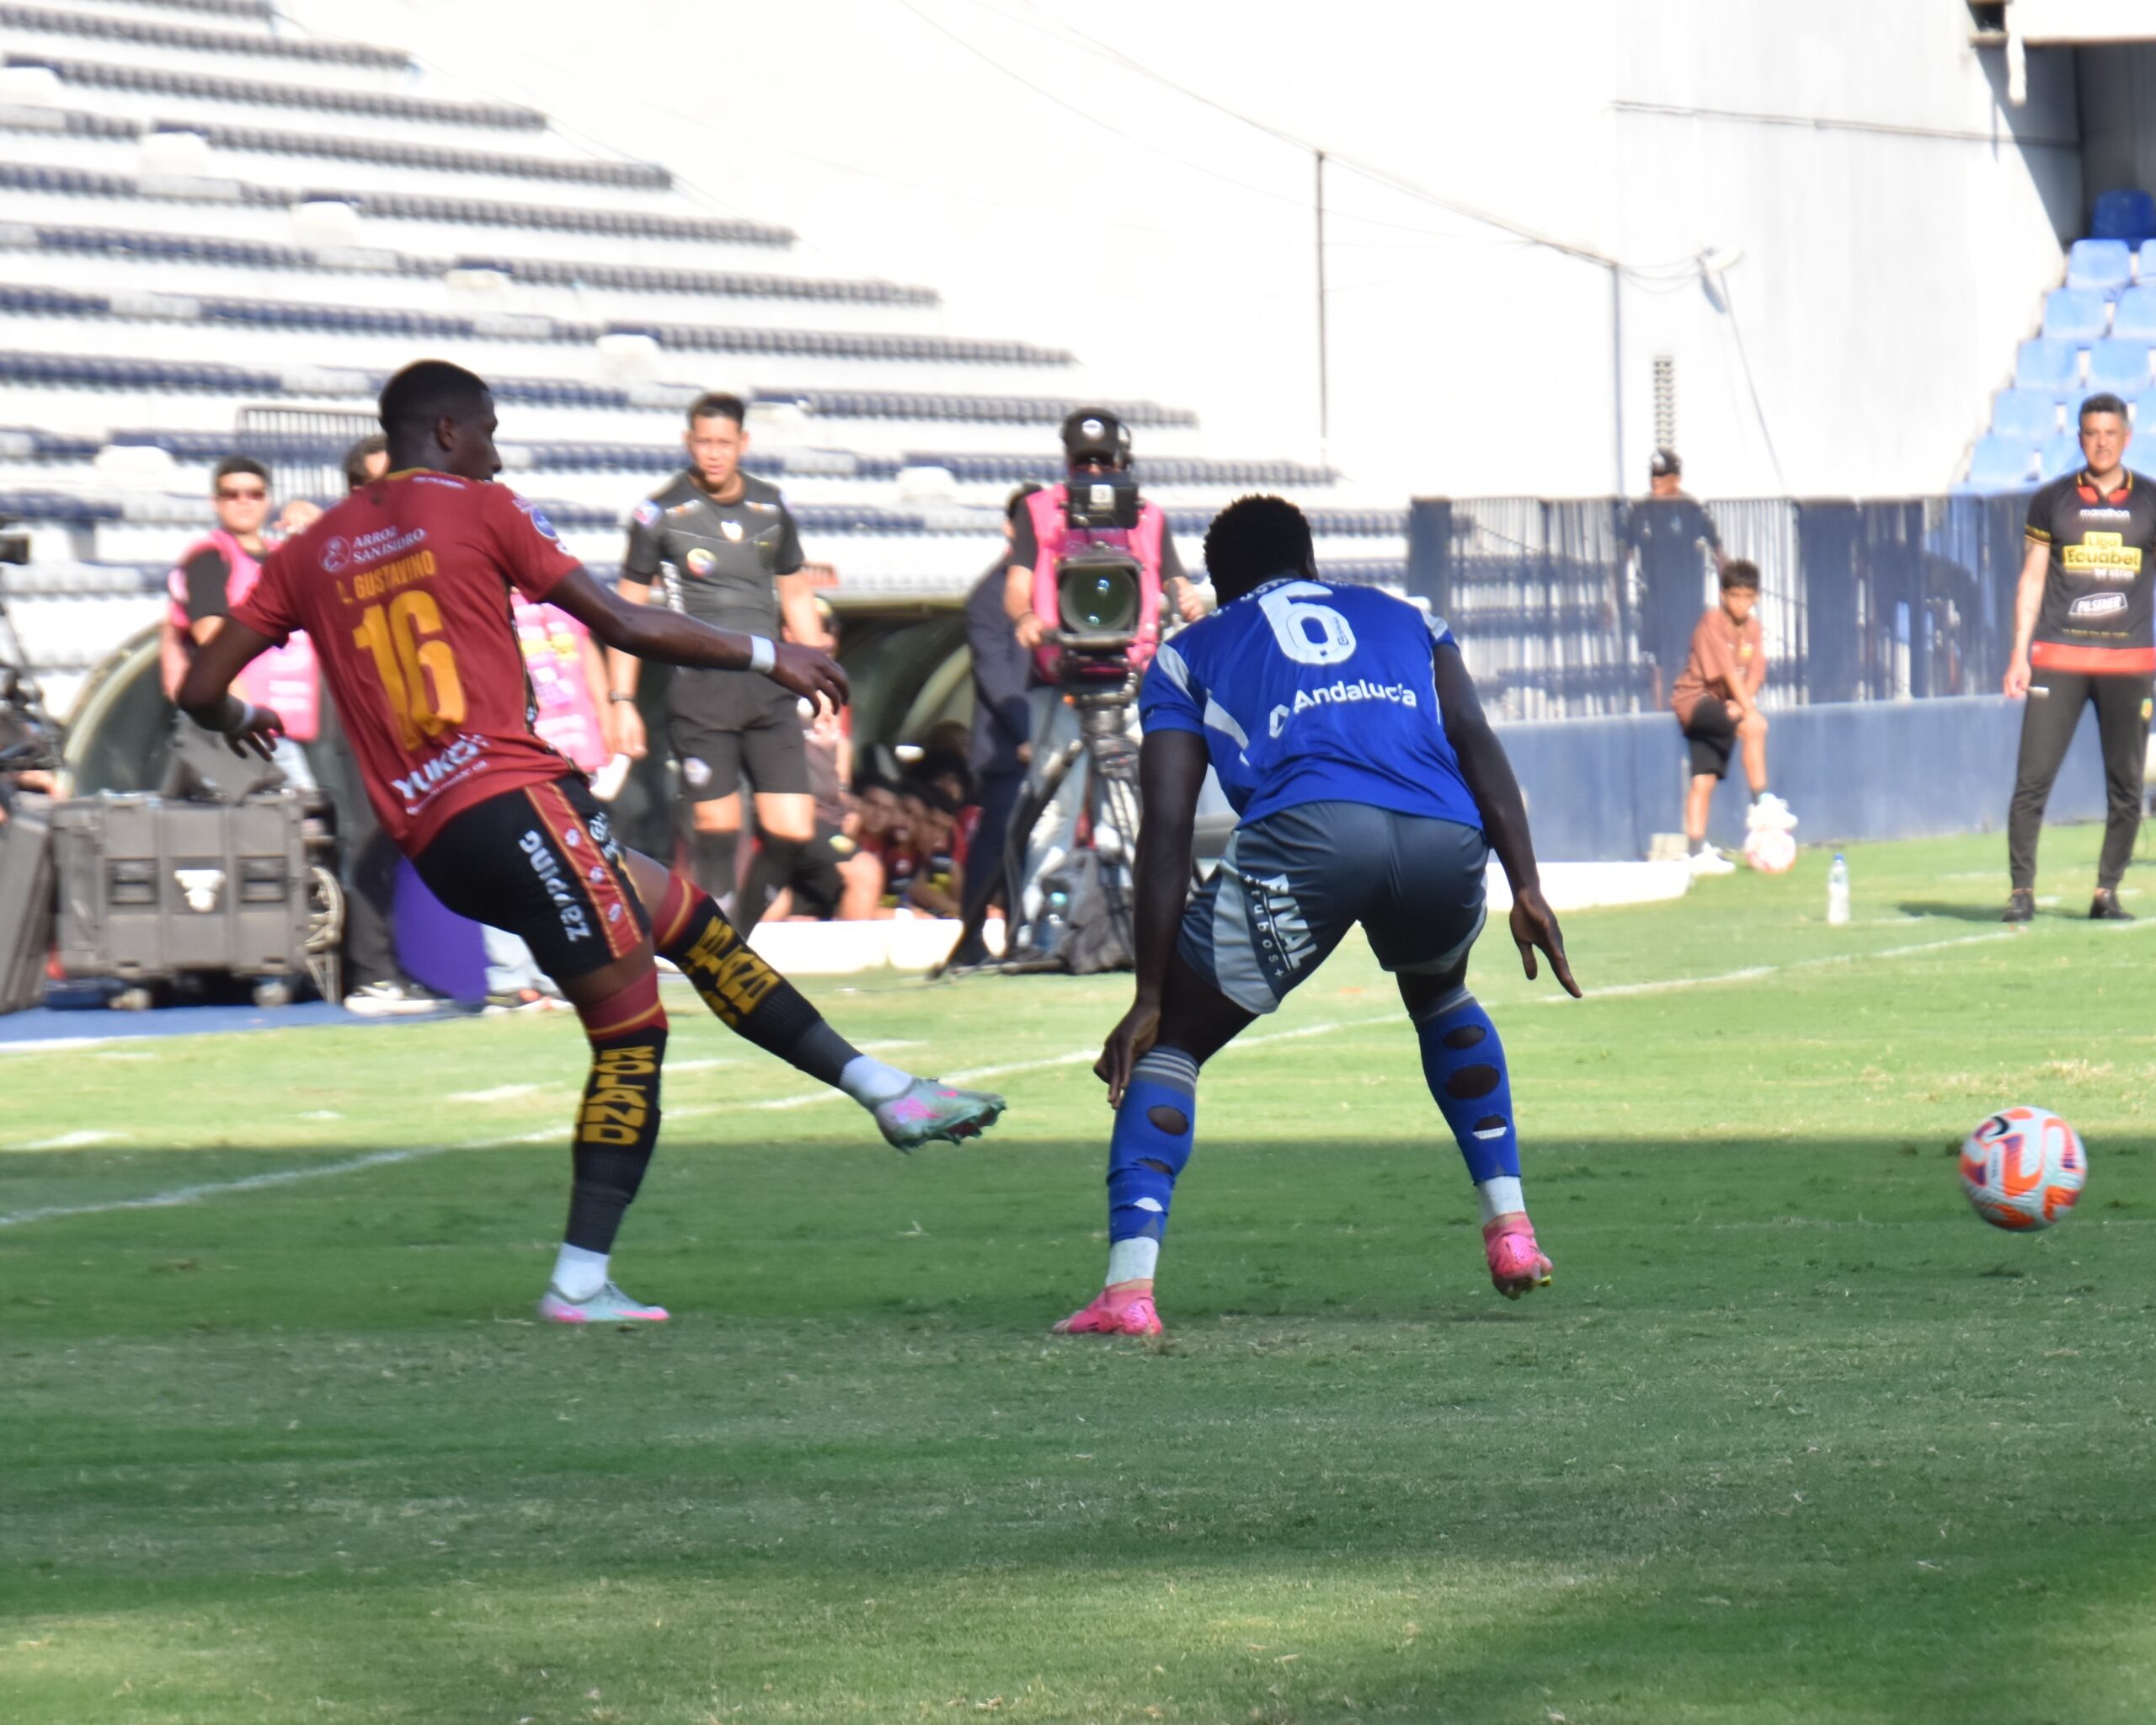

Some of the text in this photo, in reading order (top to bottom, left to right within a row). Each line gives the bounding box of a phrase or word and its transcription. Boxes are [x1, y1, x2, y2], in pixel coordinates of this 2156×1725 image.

[2089, 534, 2117, 549] Liga
[1258, 581, 1357, 665] 6
[352, 590, 467, 750] 16
